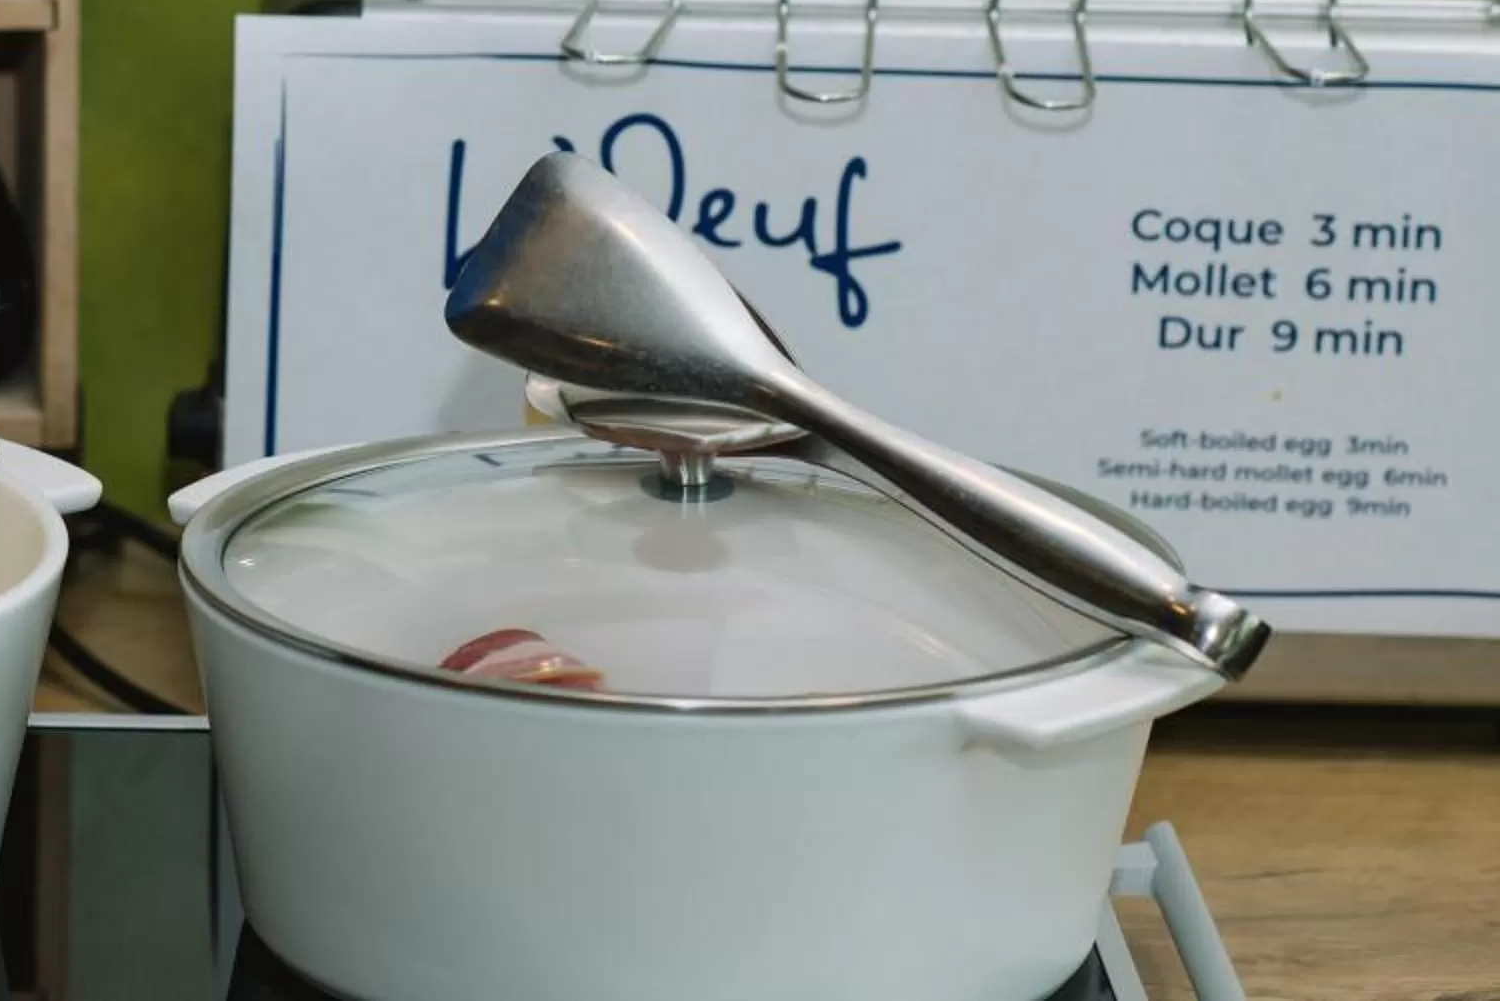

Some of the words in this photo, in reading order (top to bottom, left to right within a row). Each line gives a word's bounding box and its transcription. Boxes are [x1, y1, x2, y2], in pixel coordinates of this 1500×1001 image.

[1131, 209, 1285, 253] Coque
[1310, 214, 1337, 247] 3
[1351, 215, 1443, 251] min
[1130, 263, 1278, 298] Mollet
[1304, 268, 1333, 301] 6
[1347, 268, 1438, 304] min
[1158, 315, 1244, 351] Dur
[1271, 320, 1299, 353] 9
[1313, 320, 1404, 356] min
[1140, 429, 1277, 451] Soft-boiled
[1284, 437, 1332, 458] egg
[1098, 457, 1227, 480] Semi-hard
[1234, 464, 1313, 484] mollet
[1321, 469, 1370, 490] egg
[1130, 490, 1277, 513] Hard-boiled
[1285, 499, 1333, 518] egg
